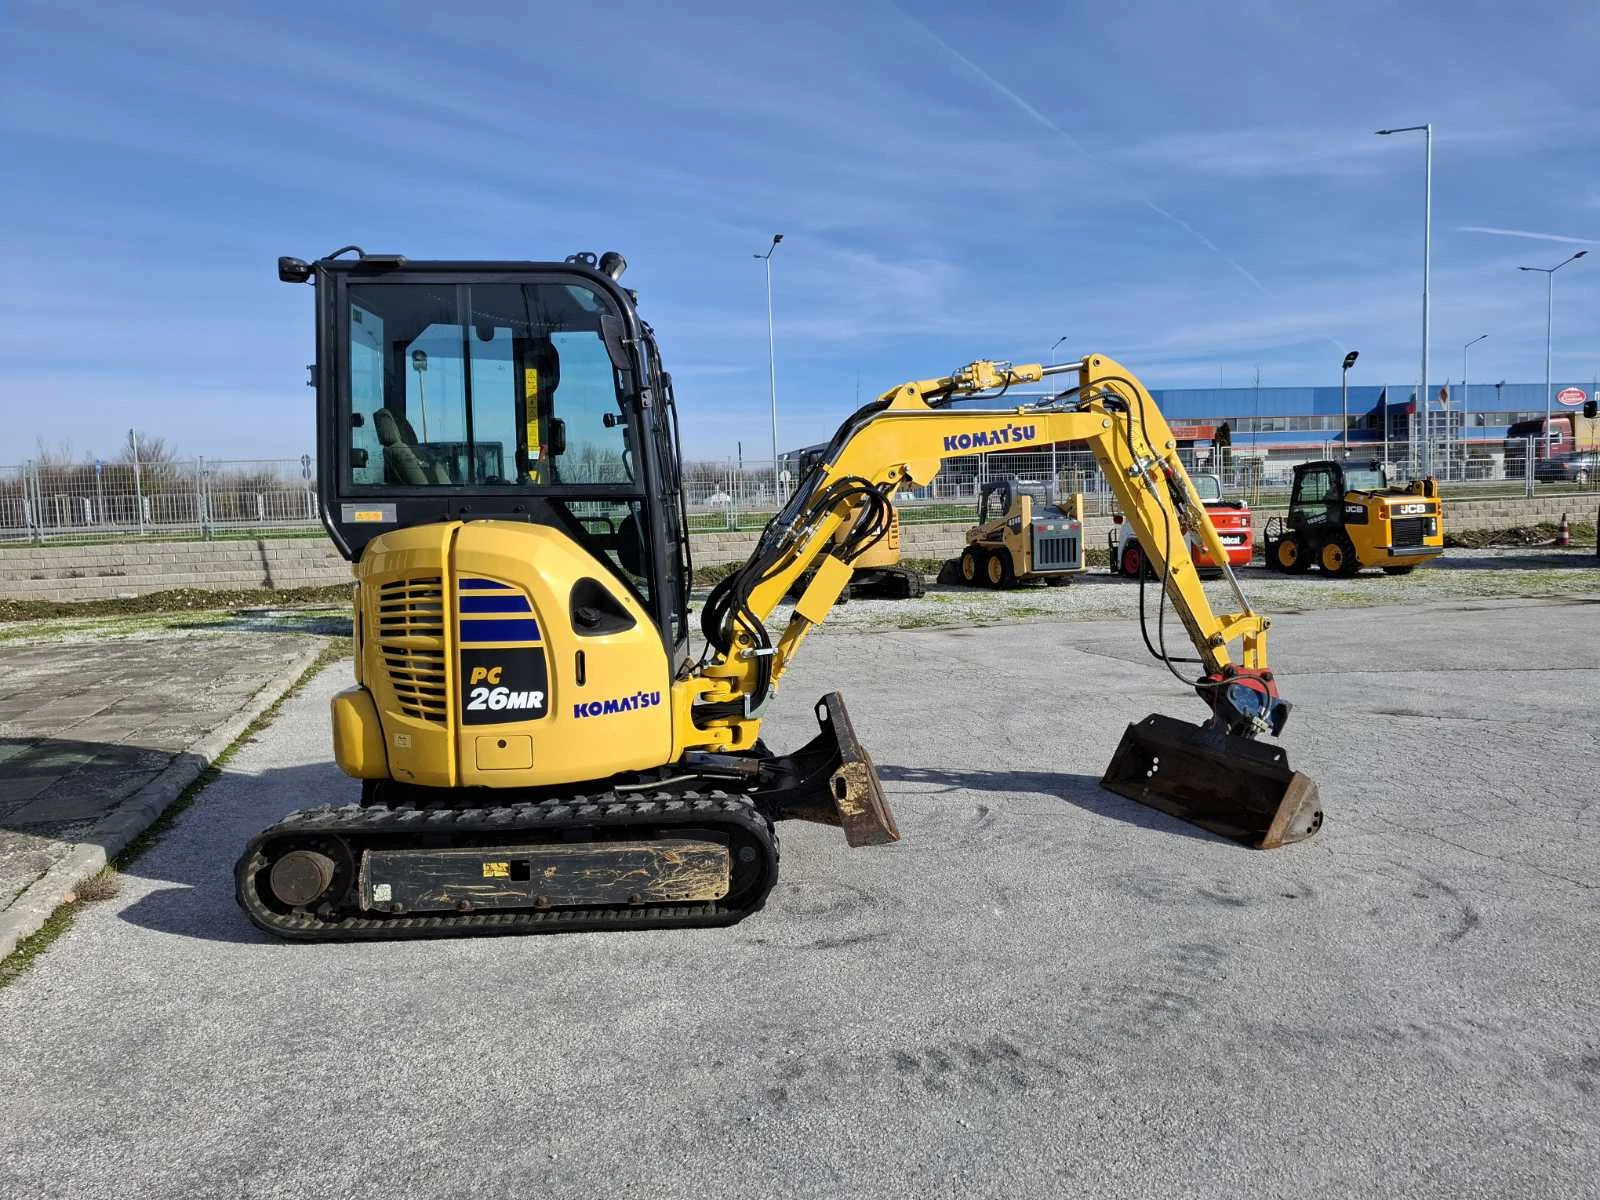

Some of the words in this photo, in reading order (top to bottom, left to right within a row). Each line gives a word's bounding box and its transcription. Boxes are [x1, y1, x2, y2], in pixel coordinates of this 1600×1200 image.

[943, 424, 1035, 451] KOMATSU
[1345, 505, 1364, 513] JCB
[1400, 504, 1425, 514] JCB
[470, 666, 503, 685] PC
[466, 686, 544, 710] 26MR
[573, 691, 660, 719] KOMATSU
